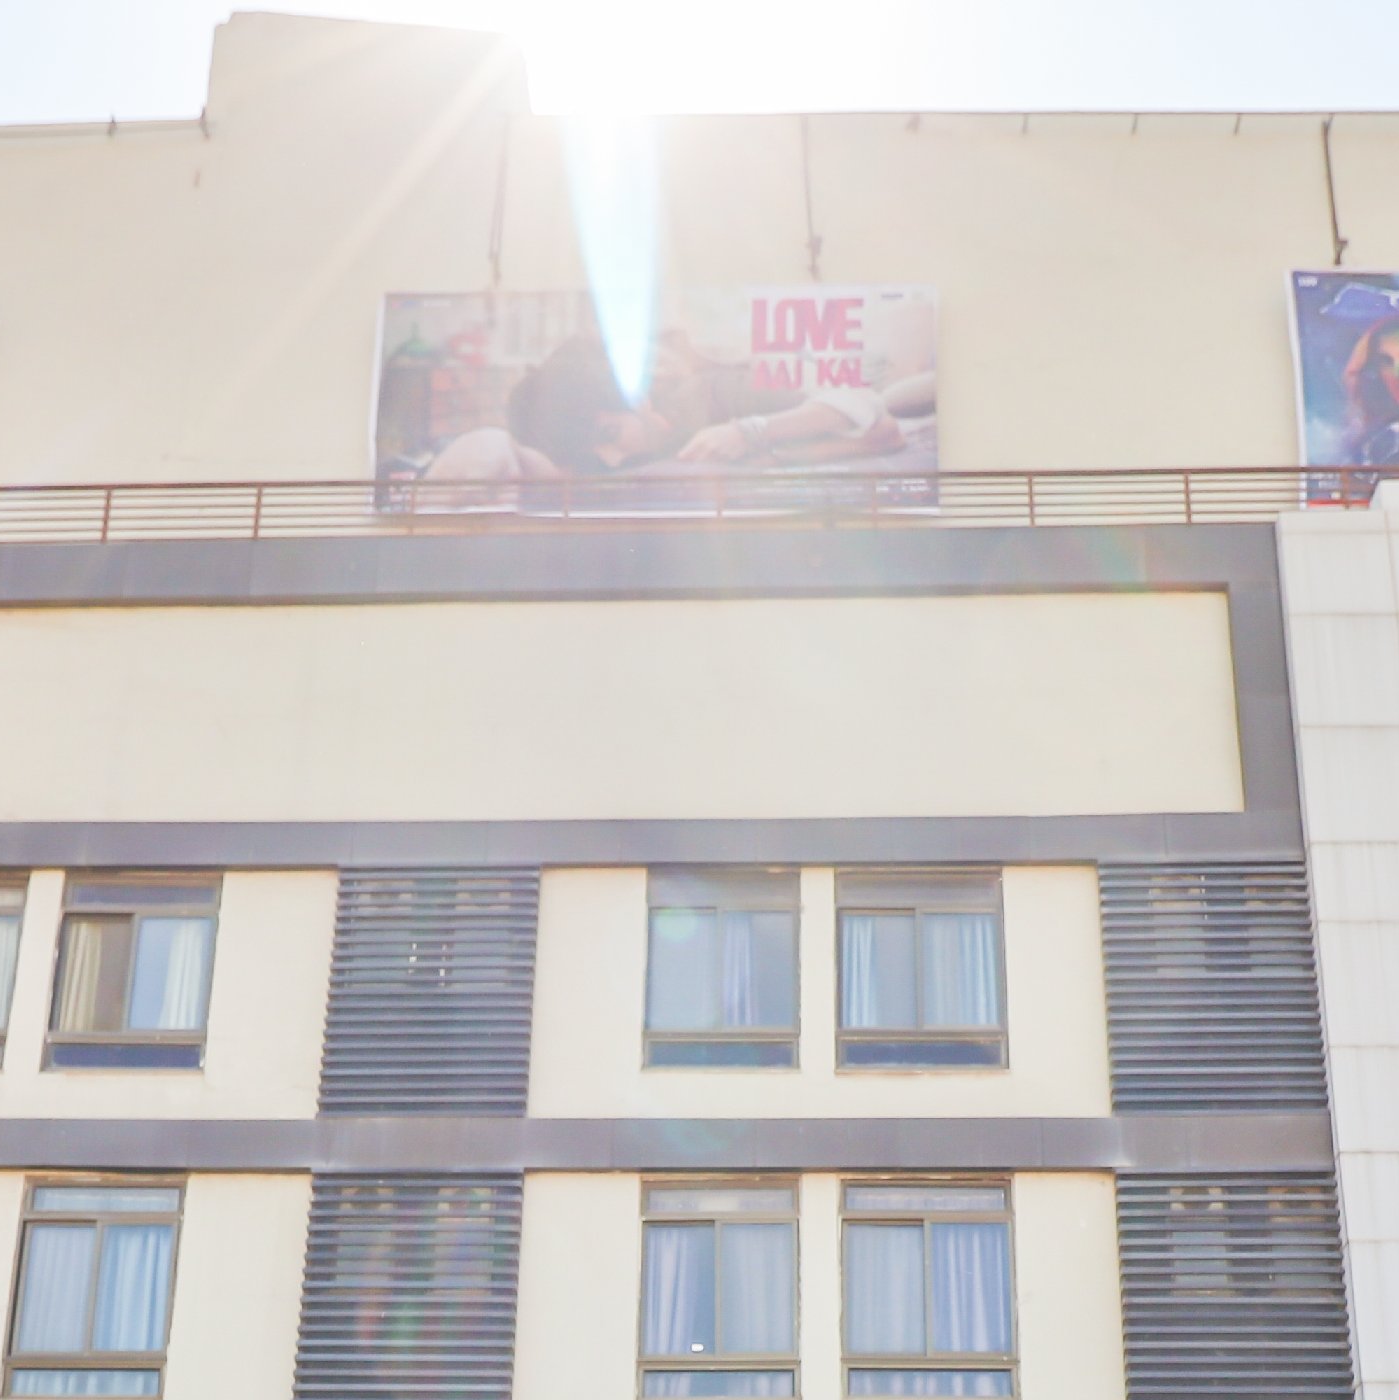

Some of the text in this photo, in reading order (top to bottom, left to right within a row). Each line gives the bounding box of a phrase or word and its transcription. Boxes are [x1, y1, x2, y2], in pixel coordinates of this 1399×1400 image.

[752, 298, 864, 354] LOVE
[752, 357, 872, 391] AAJ KAL
